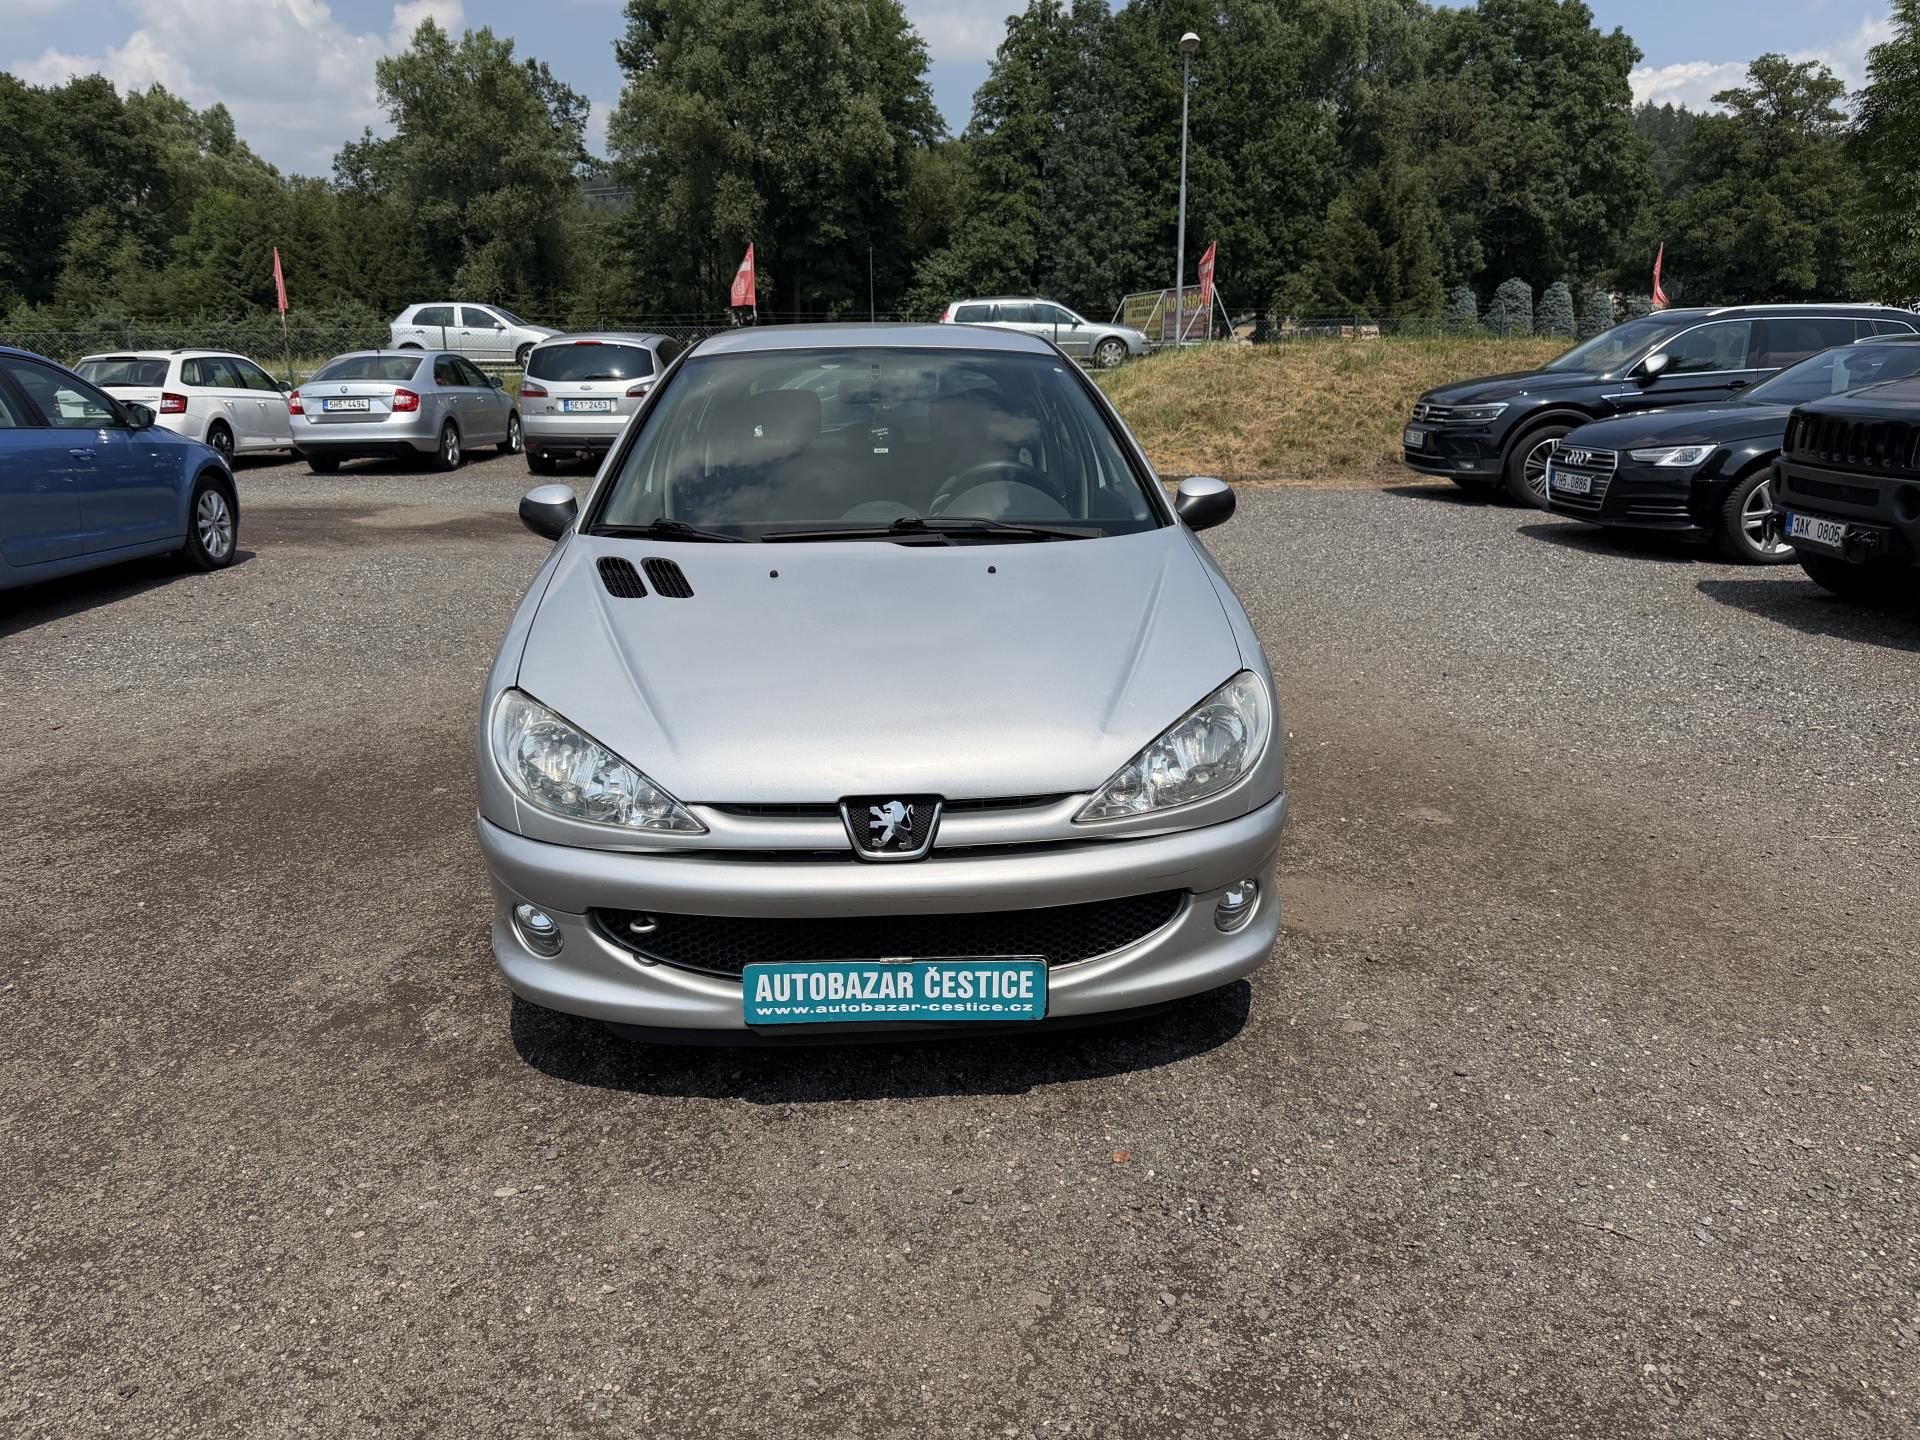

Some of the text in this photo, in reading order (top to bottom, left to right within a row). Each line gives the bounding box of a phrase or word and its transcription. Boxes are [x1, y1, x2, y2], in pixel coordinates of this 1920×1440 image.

[347, 400, 366, 408] 4494
[570, 401, 607, 409] 5E1 2453
[1555, 473, 1588, 490] 7H5 0886
[1793, 517, 1841, 543] 3AK 0805
[755, 966, 1034, 1003] AUTOBAZAR ČESTICE
[755, 1001, 1034, 1016] www.autobazar-cestice.cz
